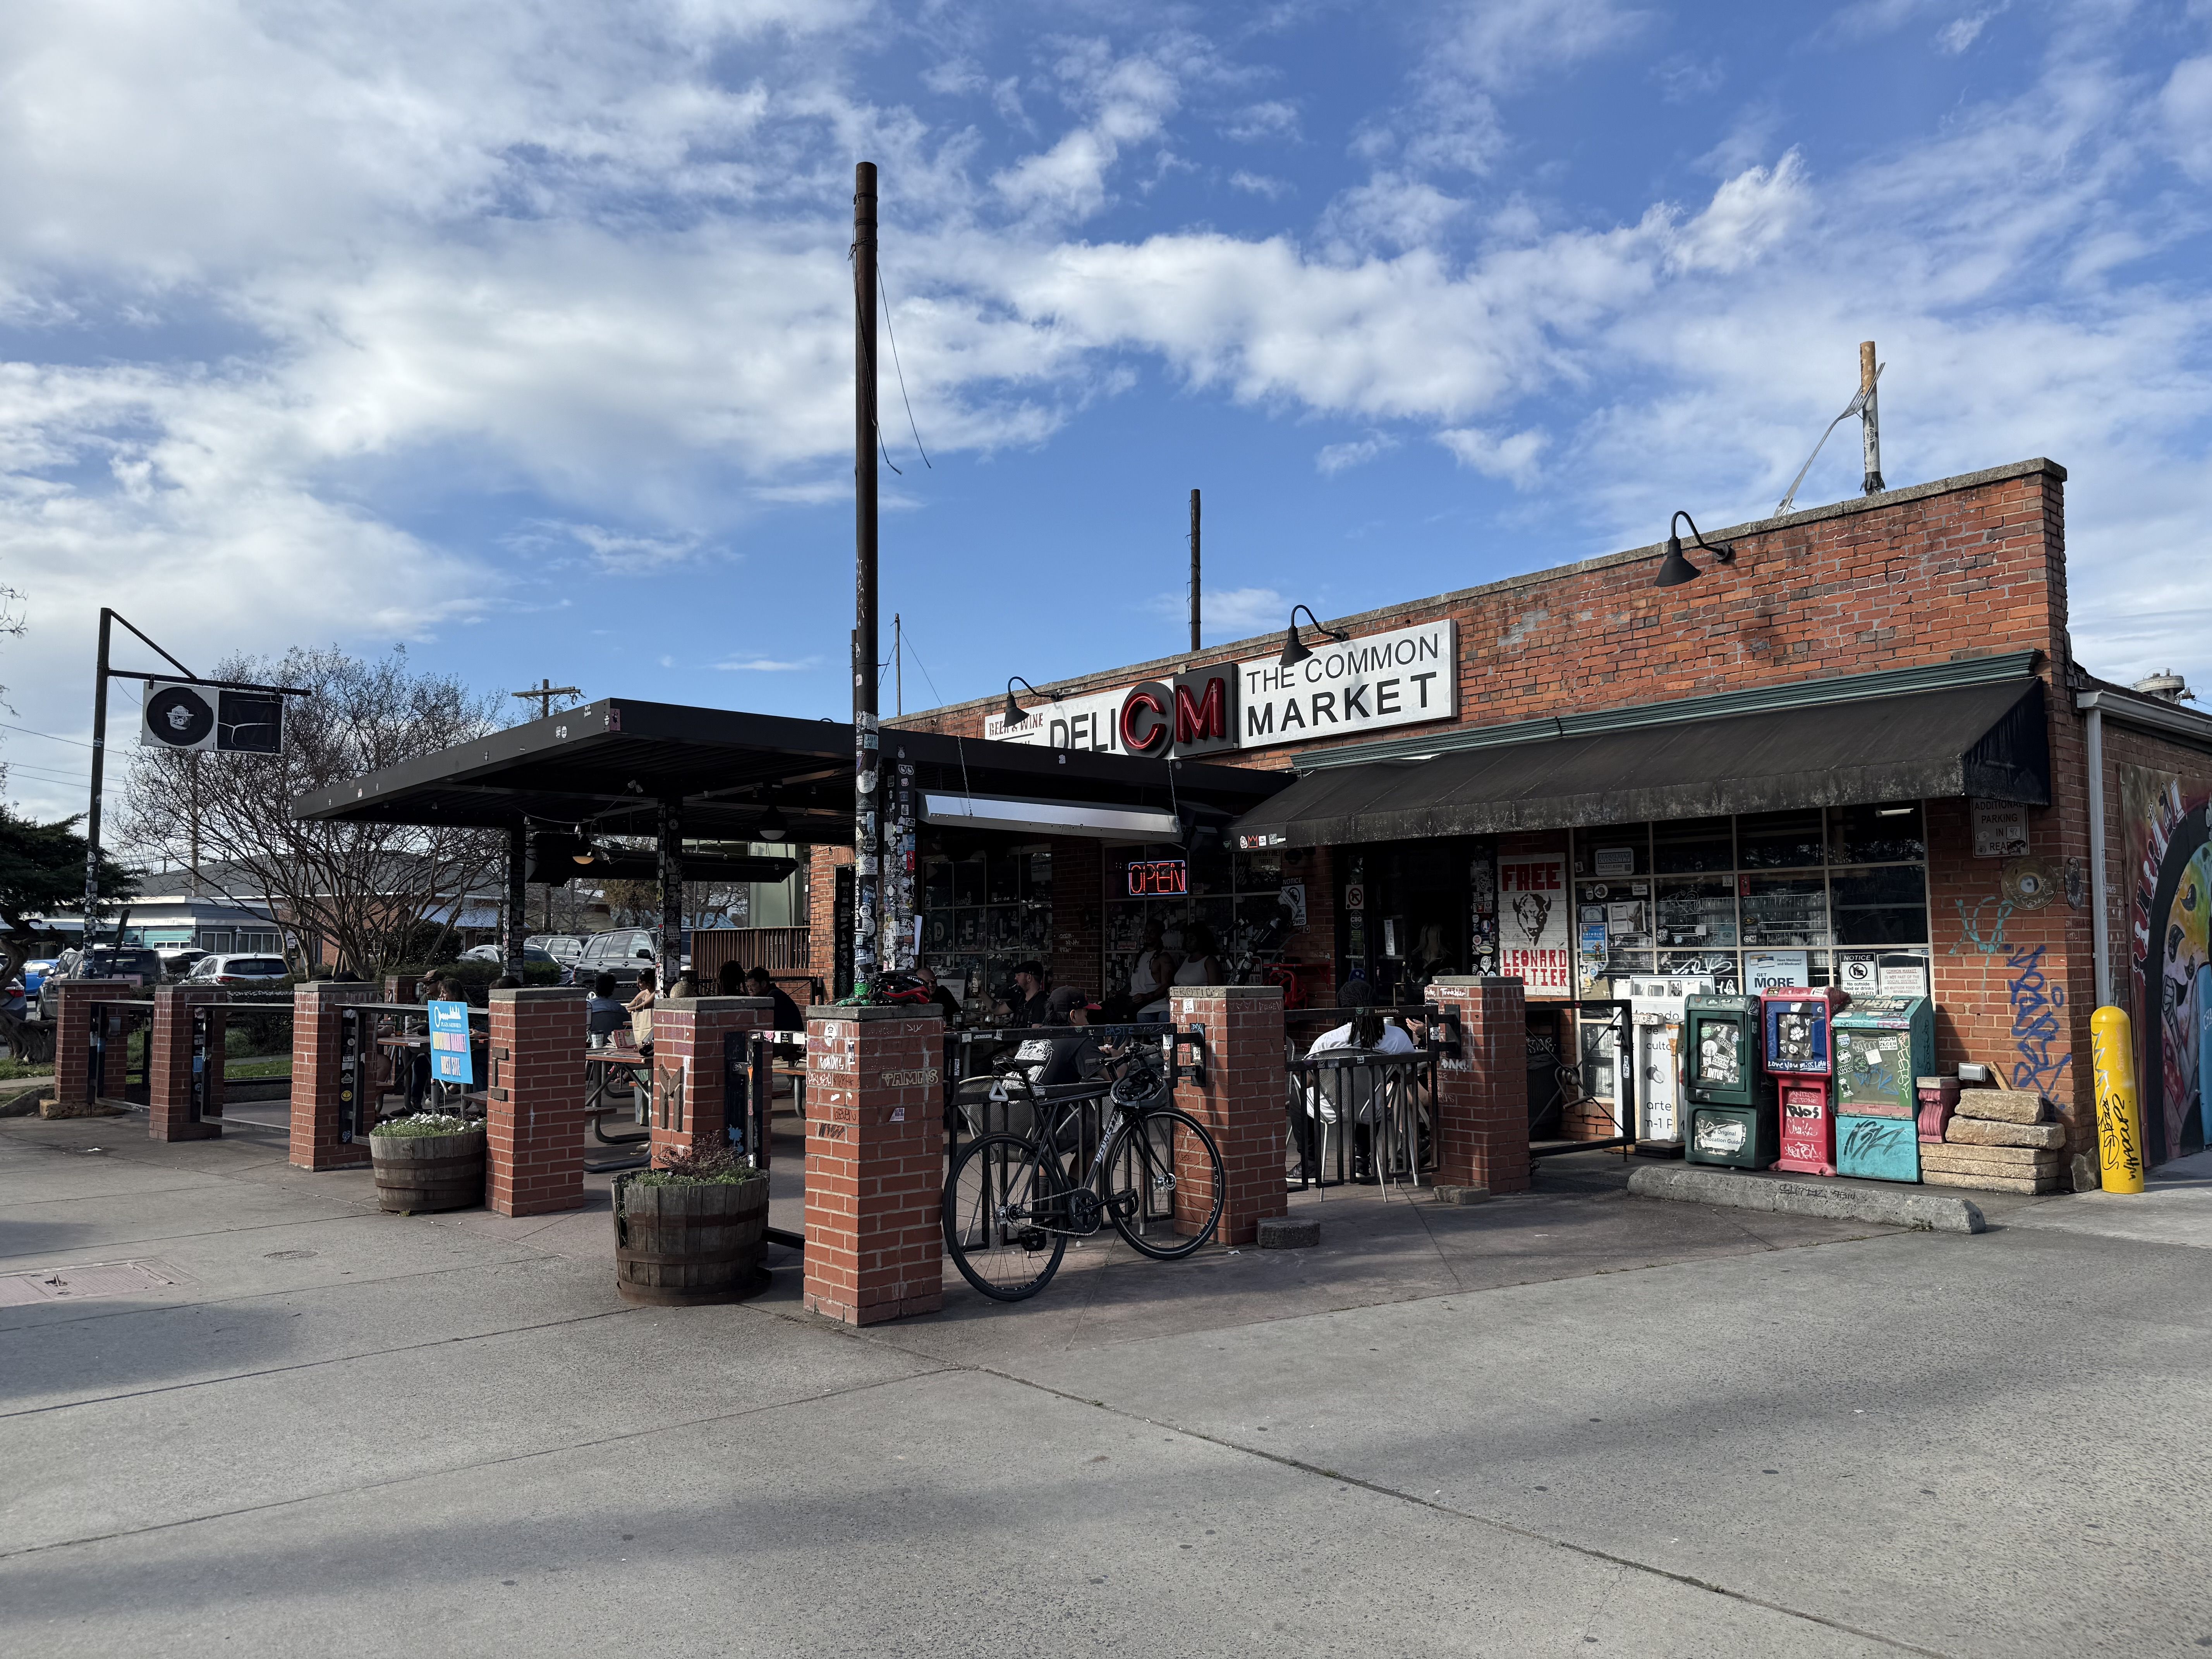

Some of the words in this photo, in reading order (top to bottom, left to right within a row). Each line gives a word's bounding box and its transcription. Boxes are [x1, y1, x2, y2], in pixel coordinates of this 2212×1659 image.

[1247, 665, 1295, 696] THE
[1305, 633, 1439, 683] COMMON
[1248, 671, 1437, 737] MARKET
[1020, 712, 1043, 731] WINE
[1120, 677, 1225, 750] CM
[1050, 708, 1116, 752] DELI
[1974, 800, 2024, 811] ADDITIONAL
[1981, 813, 2018, 824] PARKING
[1996, 828, 2004, 837] IN
[1130, 862, 1185, 893] OPEN
[1501, 862, 1561, 891] FREE
[1503, 949, 1567, 967] LEONARD
[1754, 977, 1794, 988] MORE
[1105, 1026, 1135, 1036] PASTE
[1646, 1027, 1659, 1035] de
[451, 1056, 461, 1076] SITE
[1646, 1101, 1672, 1111] arte
